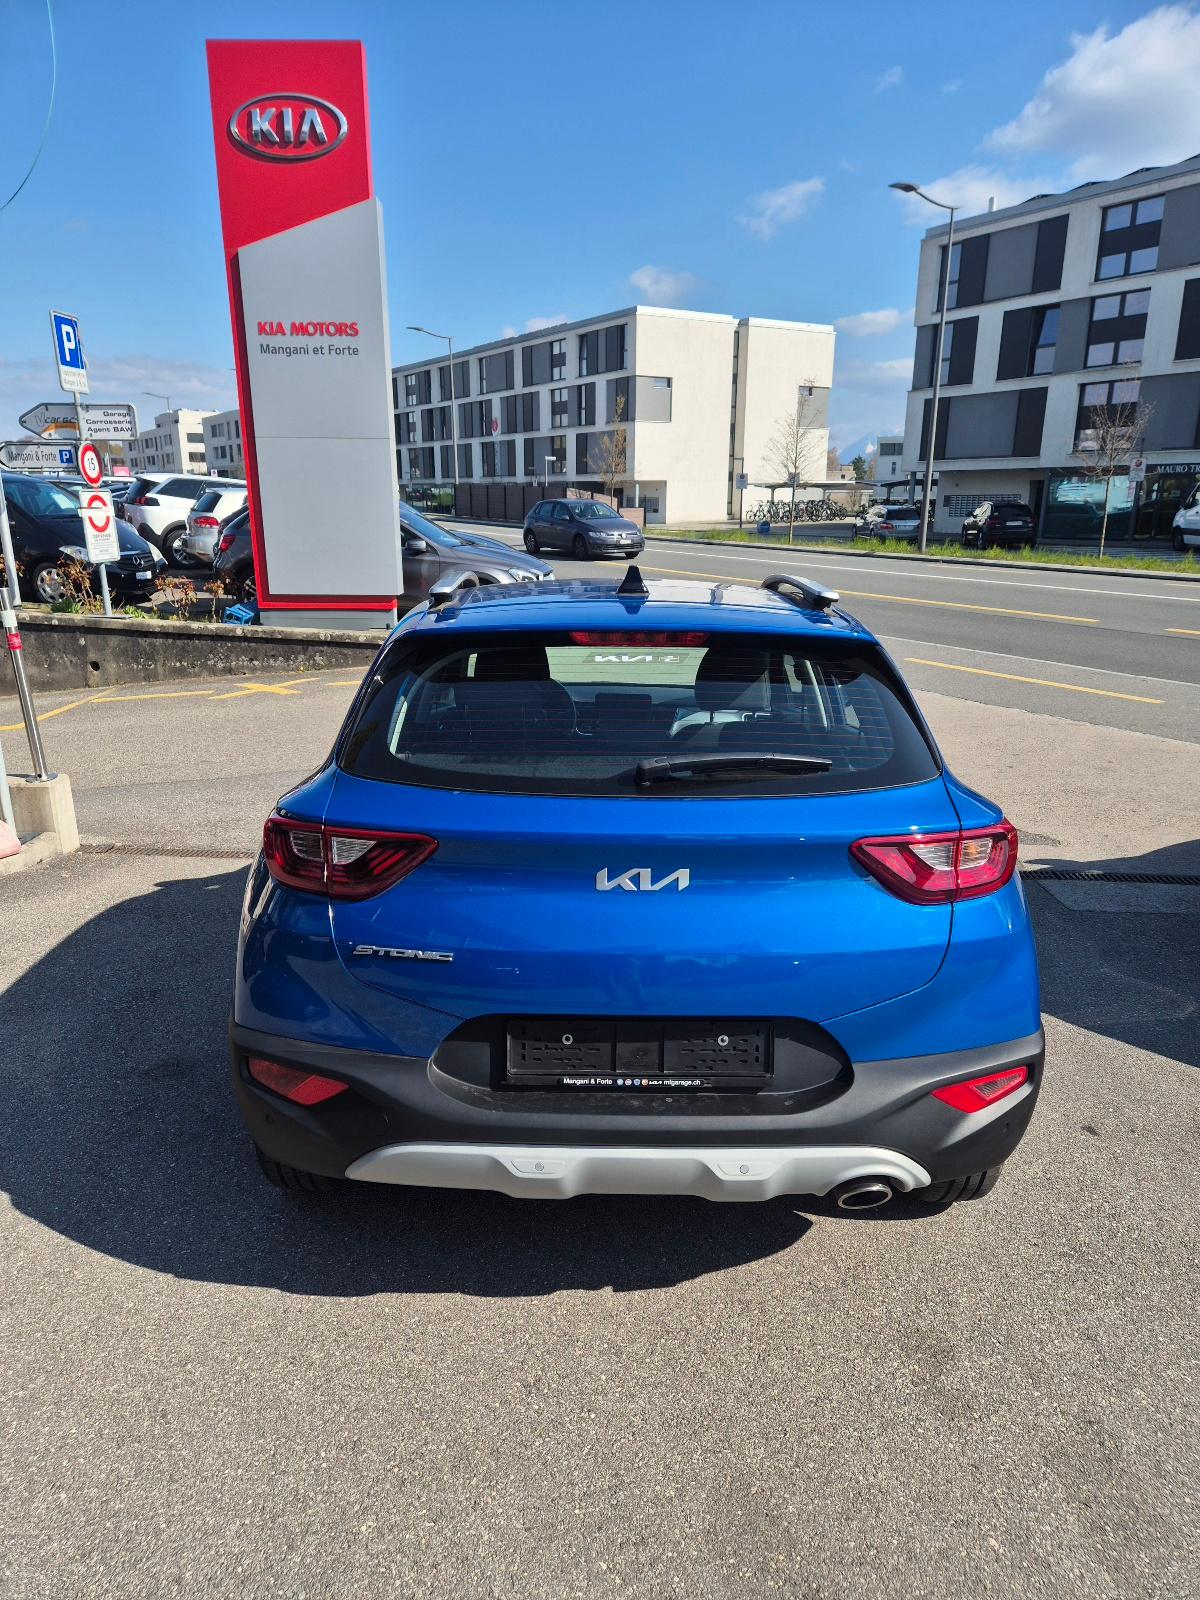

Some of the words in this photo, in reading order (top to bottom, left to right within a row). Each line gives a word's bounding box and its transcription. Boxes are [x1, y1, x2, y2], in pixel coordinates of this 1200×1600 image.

[248, 106, 328, 145] KIA
[257, 320, 287, 336] KIA
[290, 320, 360, 337] MOTORS
[61, 323, 76, 362] P
[260, 344, 309, 357] Mangani
[312, 346, 325, 356] et
[328, 344, 359, 356] Forte
[8, 450, 33, 464] Mangani
[35, 450, 40, 461] &
[41, 451, 57, 462] Forte
[62, 451, 70, 462] P
[87, 457, 96, 471] 15
[1157, 465, 1188, 473] MAURO
[596, 868, 690, 891] KIA
[353, 945, 454, 961] STONIC
[564, 1077, 589, 1086] Mangani
[664, 1078, 701, 1087] mfgarage.ch
